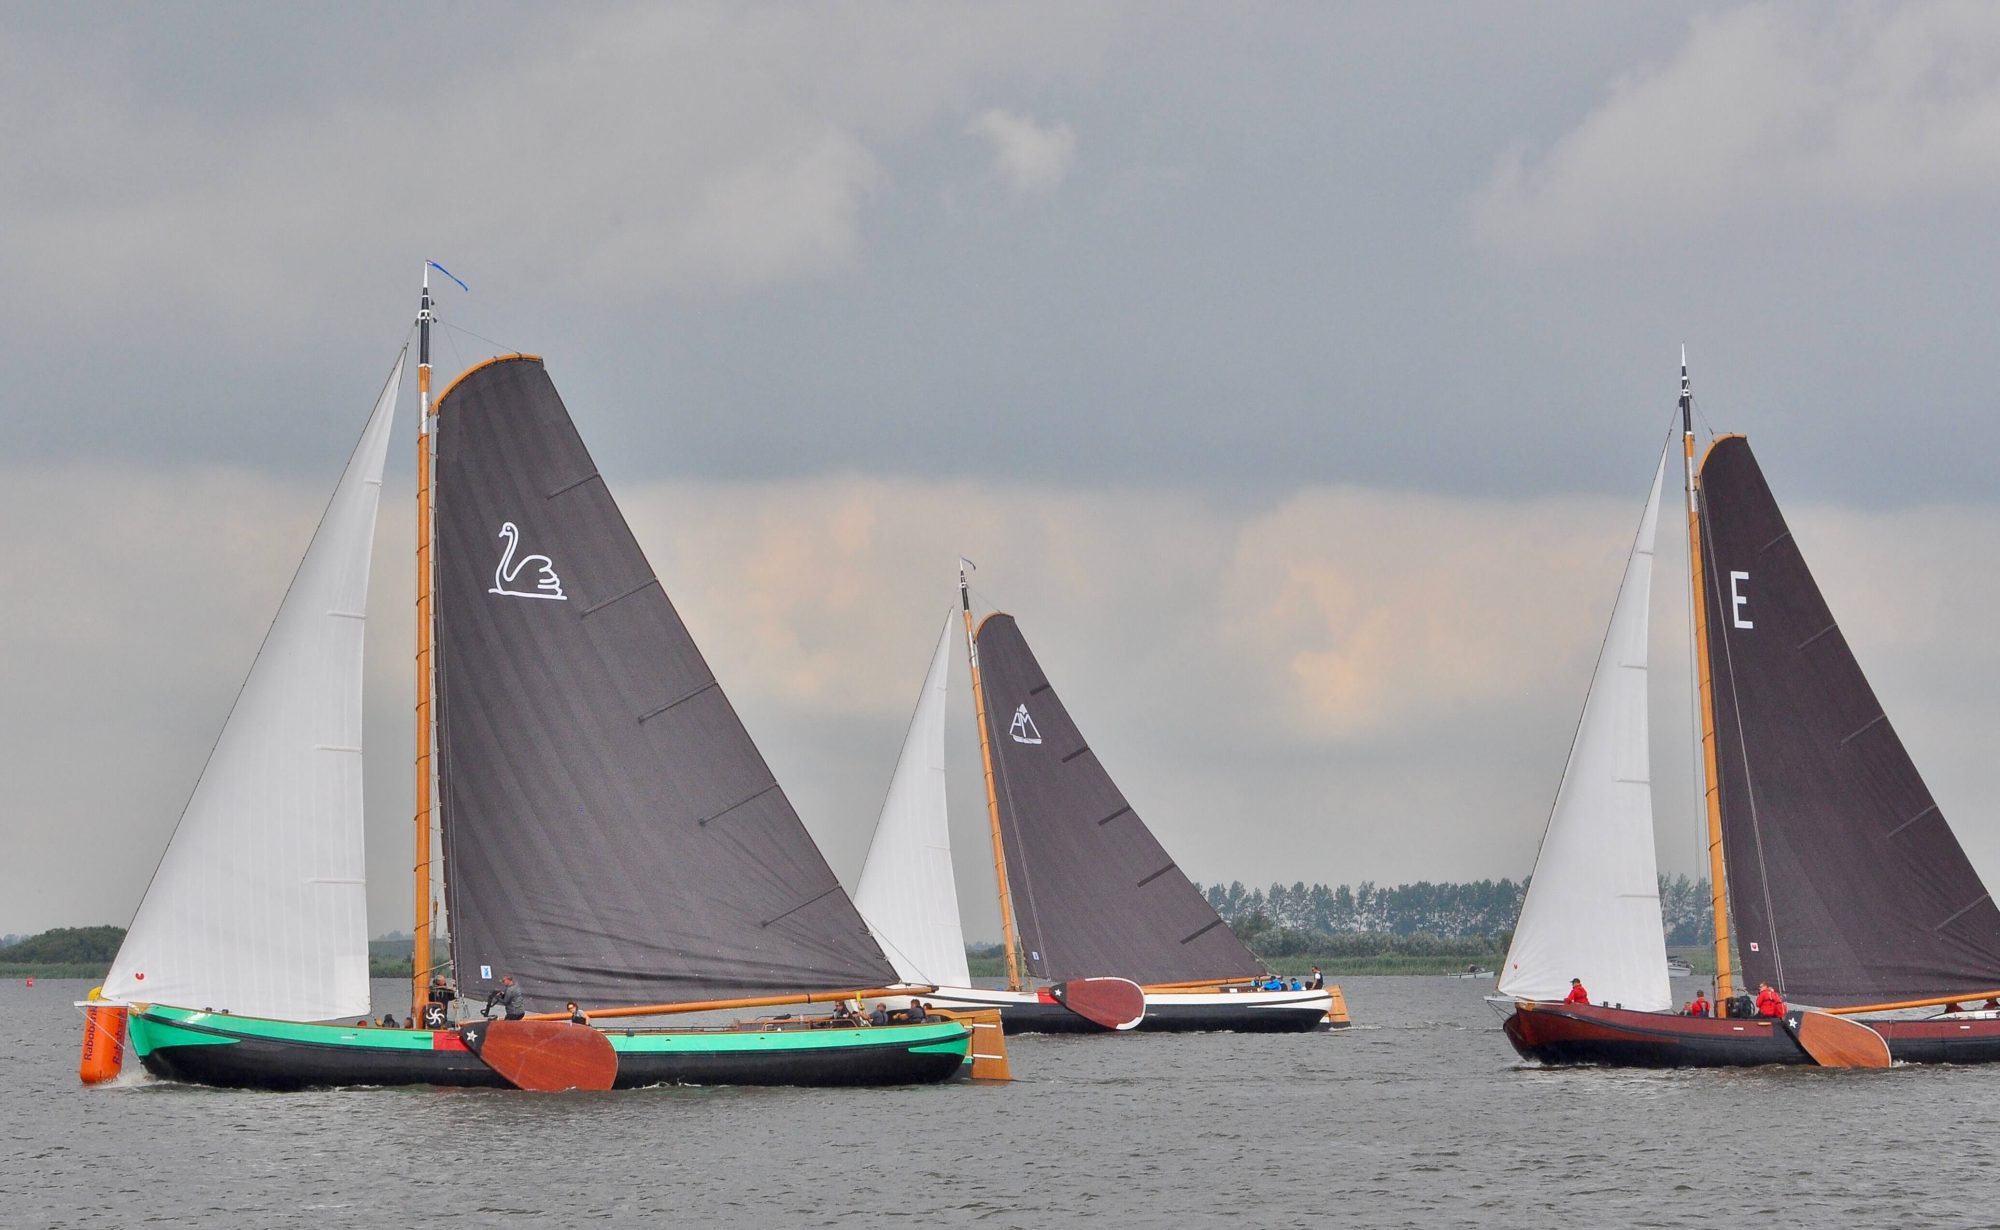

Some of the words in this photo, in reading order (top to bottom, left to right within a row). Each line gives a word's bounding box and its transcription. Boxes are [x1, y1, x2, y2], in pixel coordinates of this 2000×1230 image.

[1730, 570, 1753, 629] E
[84, 1004, 98, 1061] Rabobank
[112, 1011, 127, 1065] Rabobank
